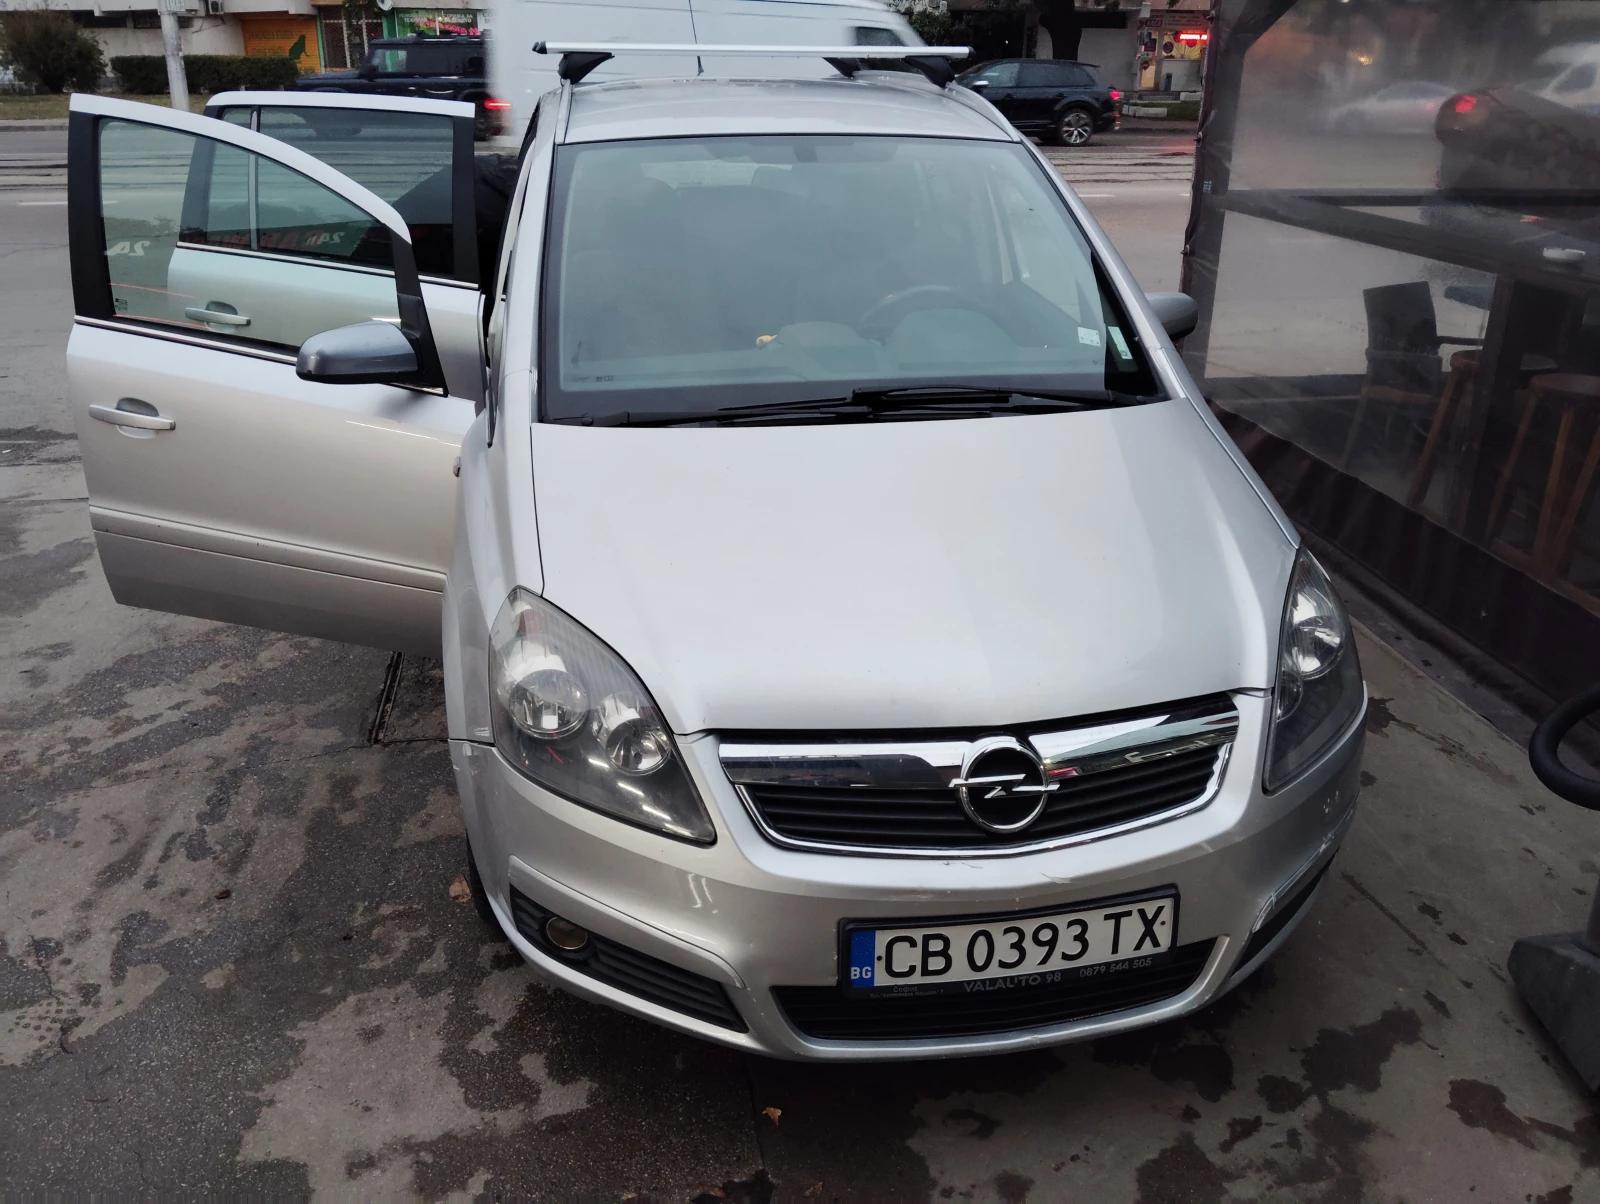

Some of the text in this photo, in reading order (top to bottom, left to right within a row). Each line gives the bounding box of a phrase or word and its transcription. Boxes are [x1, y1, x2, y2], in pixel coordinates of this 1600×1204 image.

[884, 905, 1166, 978] CB 0393 TX
[850, 966, 872, 979] BG
[1045, 971, 1062, 983] 98
[1079, 965, 1106, 978] 0879
[1109, 962, 1129, 973] 544
[1133, 957, 1153, 969] 505
